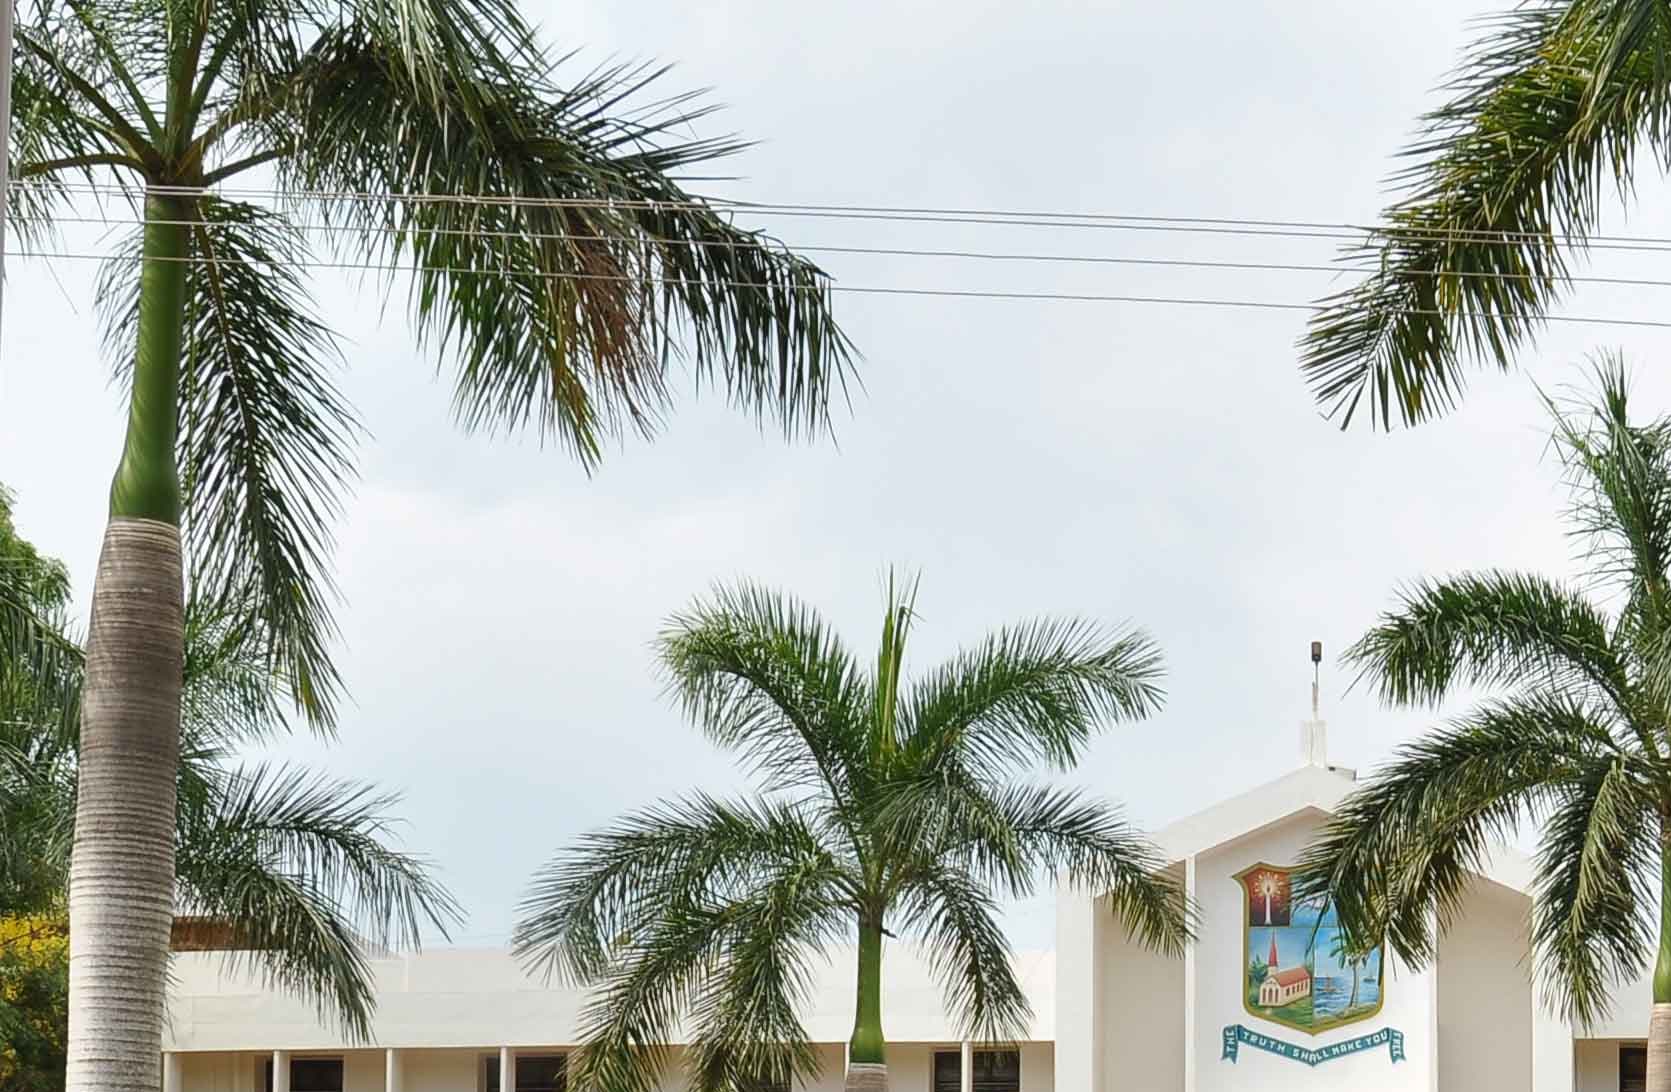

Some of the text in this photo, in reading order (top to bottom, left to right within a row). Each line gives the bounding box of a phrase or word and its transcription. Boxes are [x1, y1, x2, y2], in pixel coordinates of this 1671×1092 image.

[1225, 1029, 1236, 1053] THE
[1243, 1031, 1286, 1053] TRUTH
[1292, 1048, 1329, 1063] SHALL
[1331, 1041, 1362, 1056] MAKE
[1366, 1030, 1388, 1046] YOU
